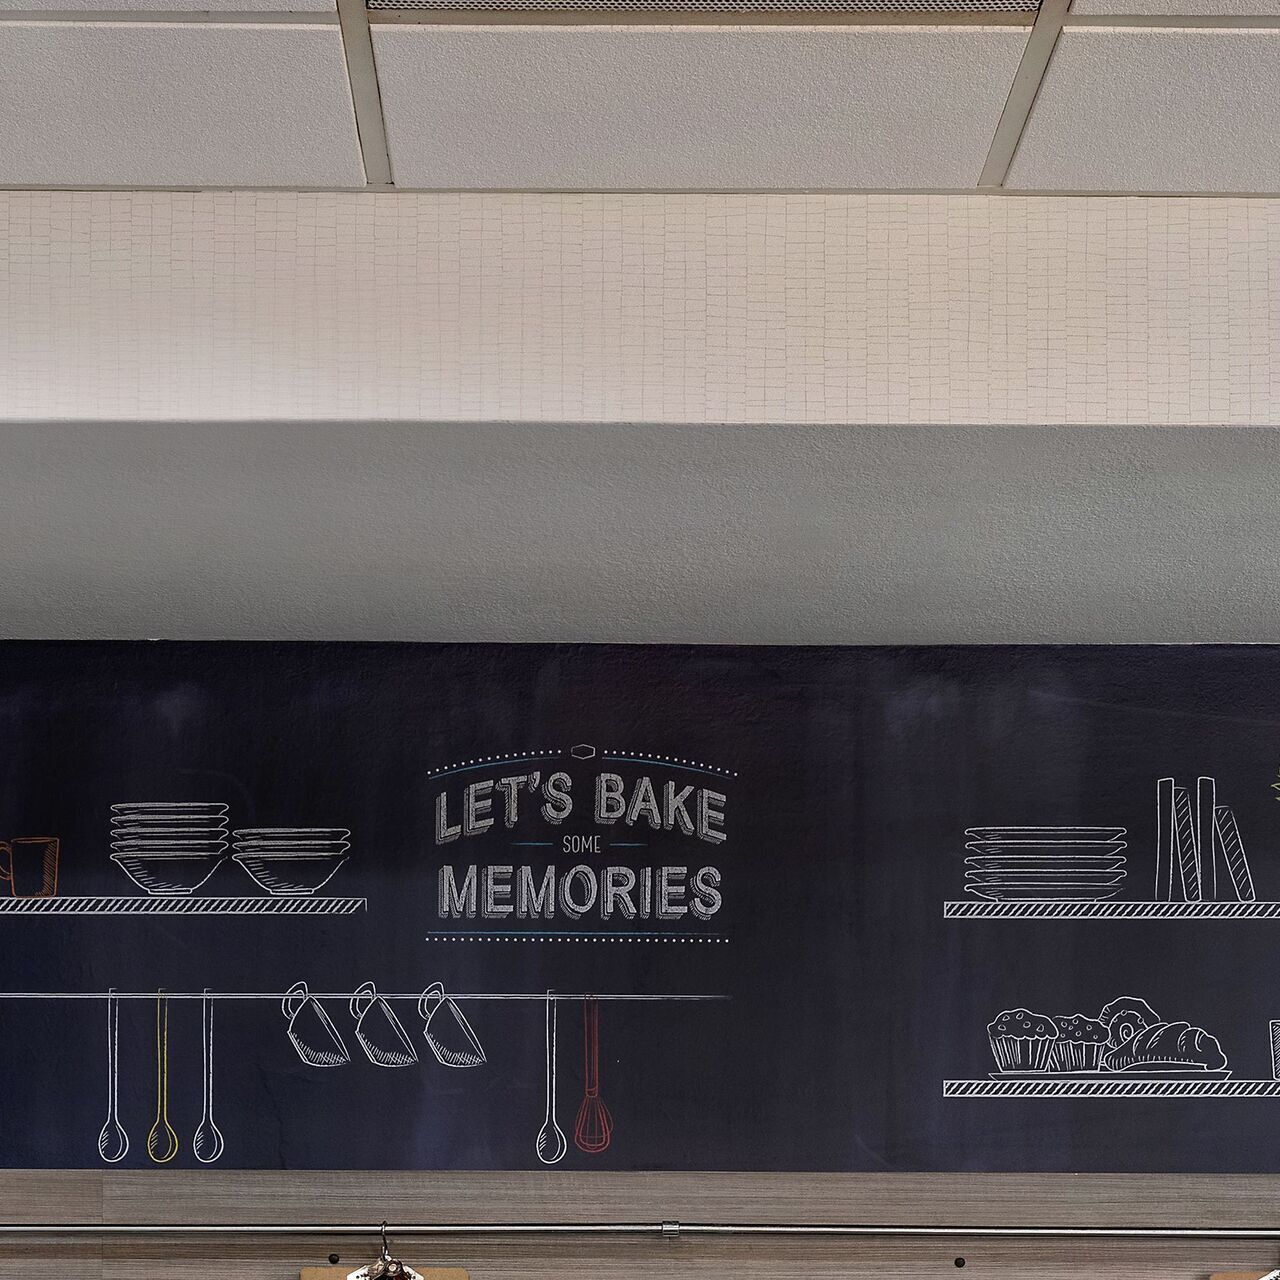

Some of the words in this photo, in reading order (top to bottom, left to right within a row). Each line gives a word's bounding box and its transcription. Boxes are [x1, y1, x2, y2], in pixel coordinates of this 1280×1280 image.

[435, 771, 573, 845] LET'S
[594, 772, 728, 845] BAKE
[562, 835, 601, 854] SOME
[438, 864, 723, 920] MEMORIES
